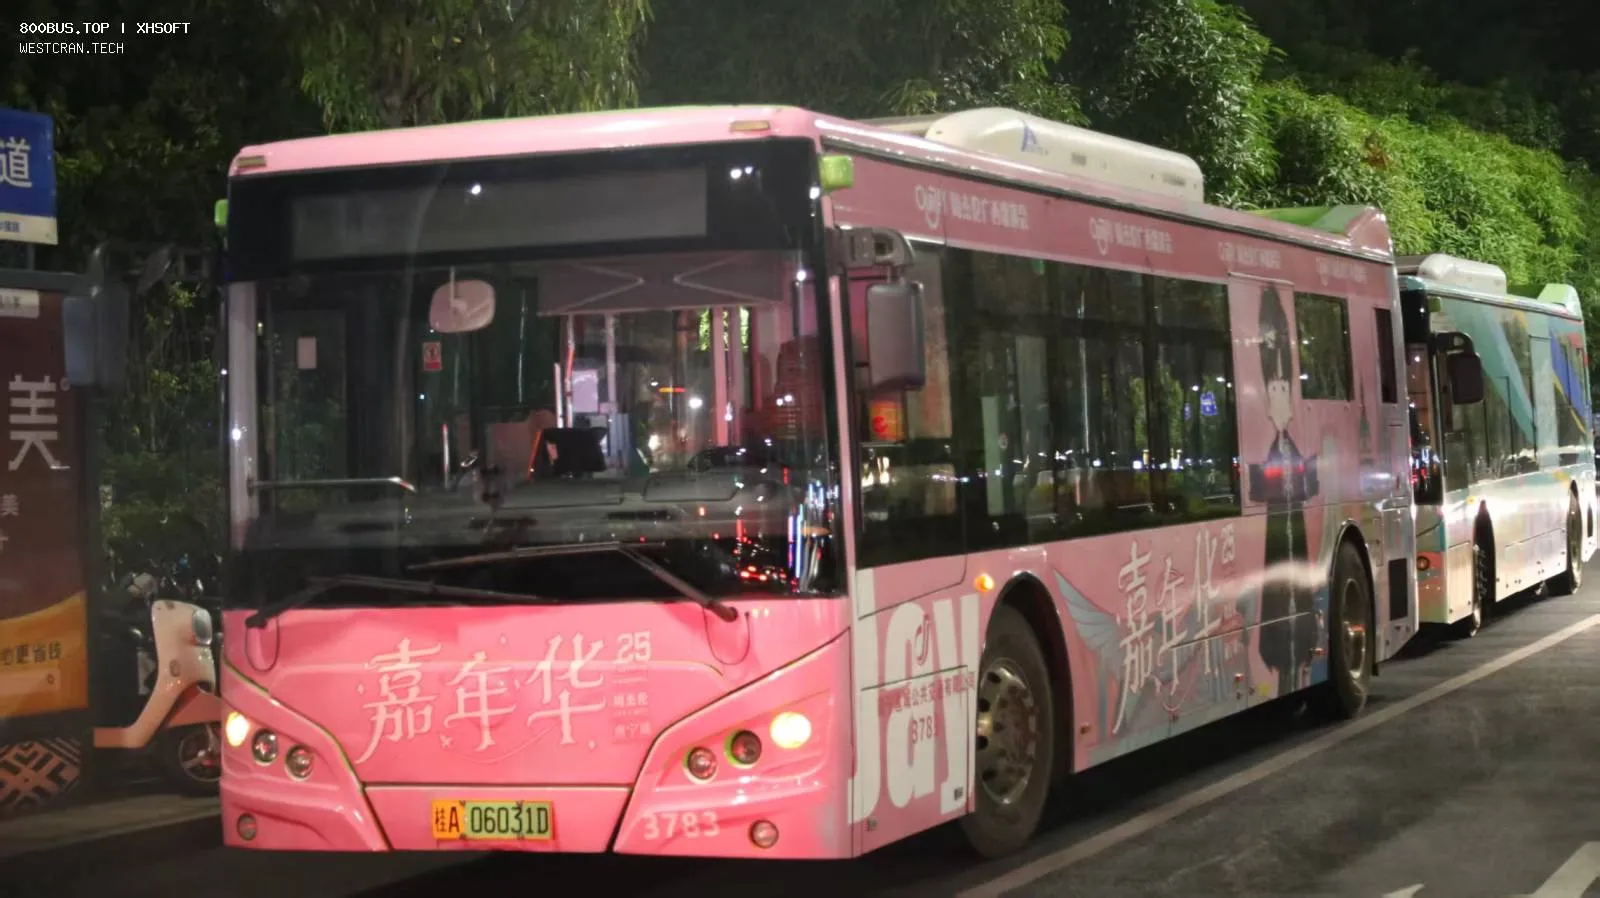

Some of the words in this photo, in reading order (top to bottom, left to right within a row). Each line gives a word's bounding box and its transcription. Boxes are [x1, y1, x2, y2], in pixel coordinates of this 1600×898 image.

[0, 136, 33, 188] 道
[8, 374, 58, 471] 美
[1112, 526, 1221, 735] 嘉年华
[353, 633, 605, 765] 嘉年华
[612, 628, 652, 665] 25
[848, 567, 980, 825] Jay
[434, 805, 460, 833] 桂A
[470, 806, 550, 835] 06031D
[642, 810, 721, 841] 3783
